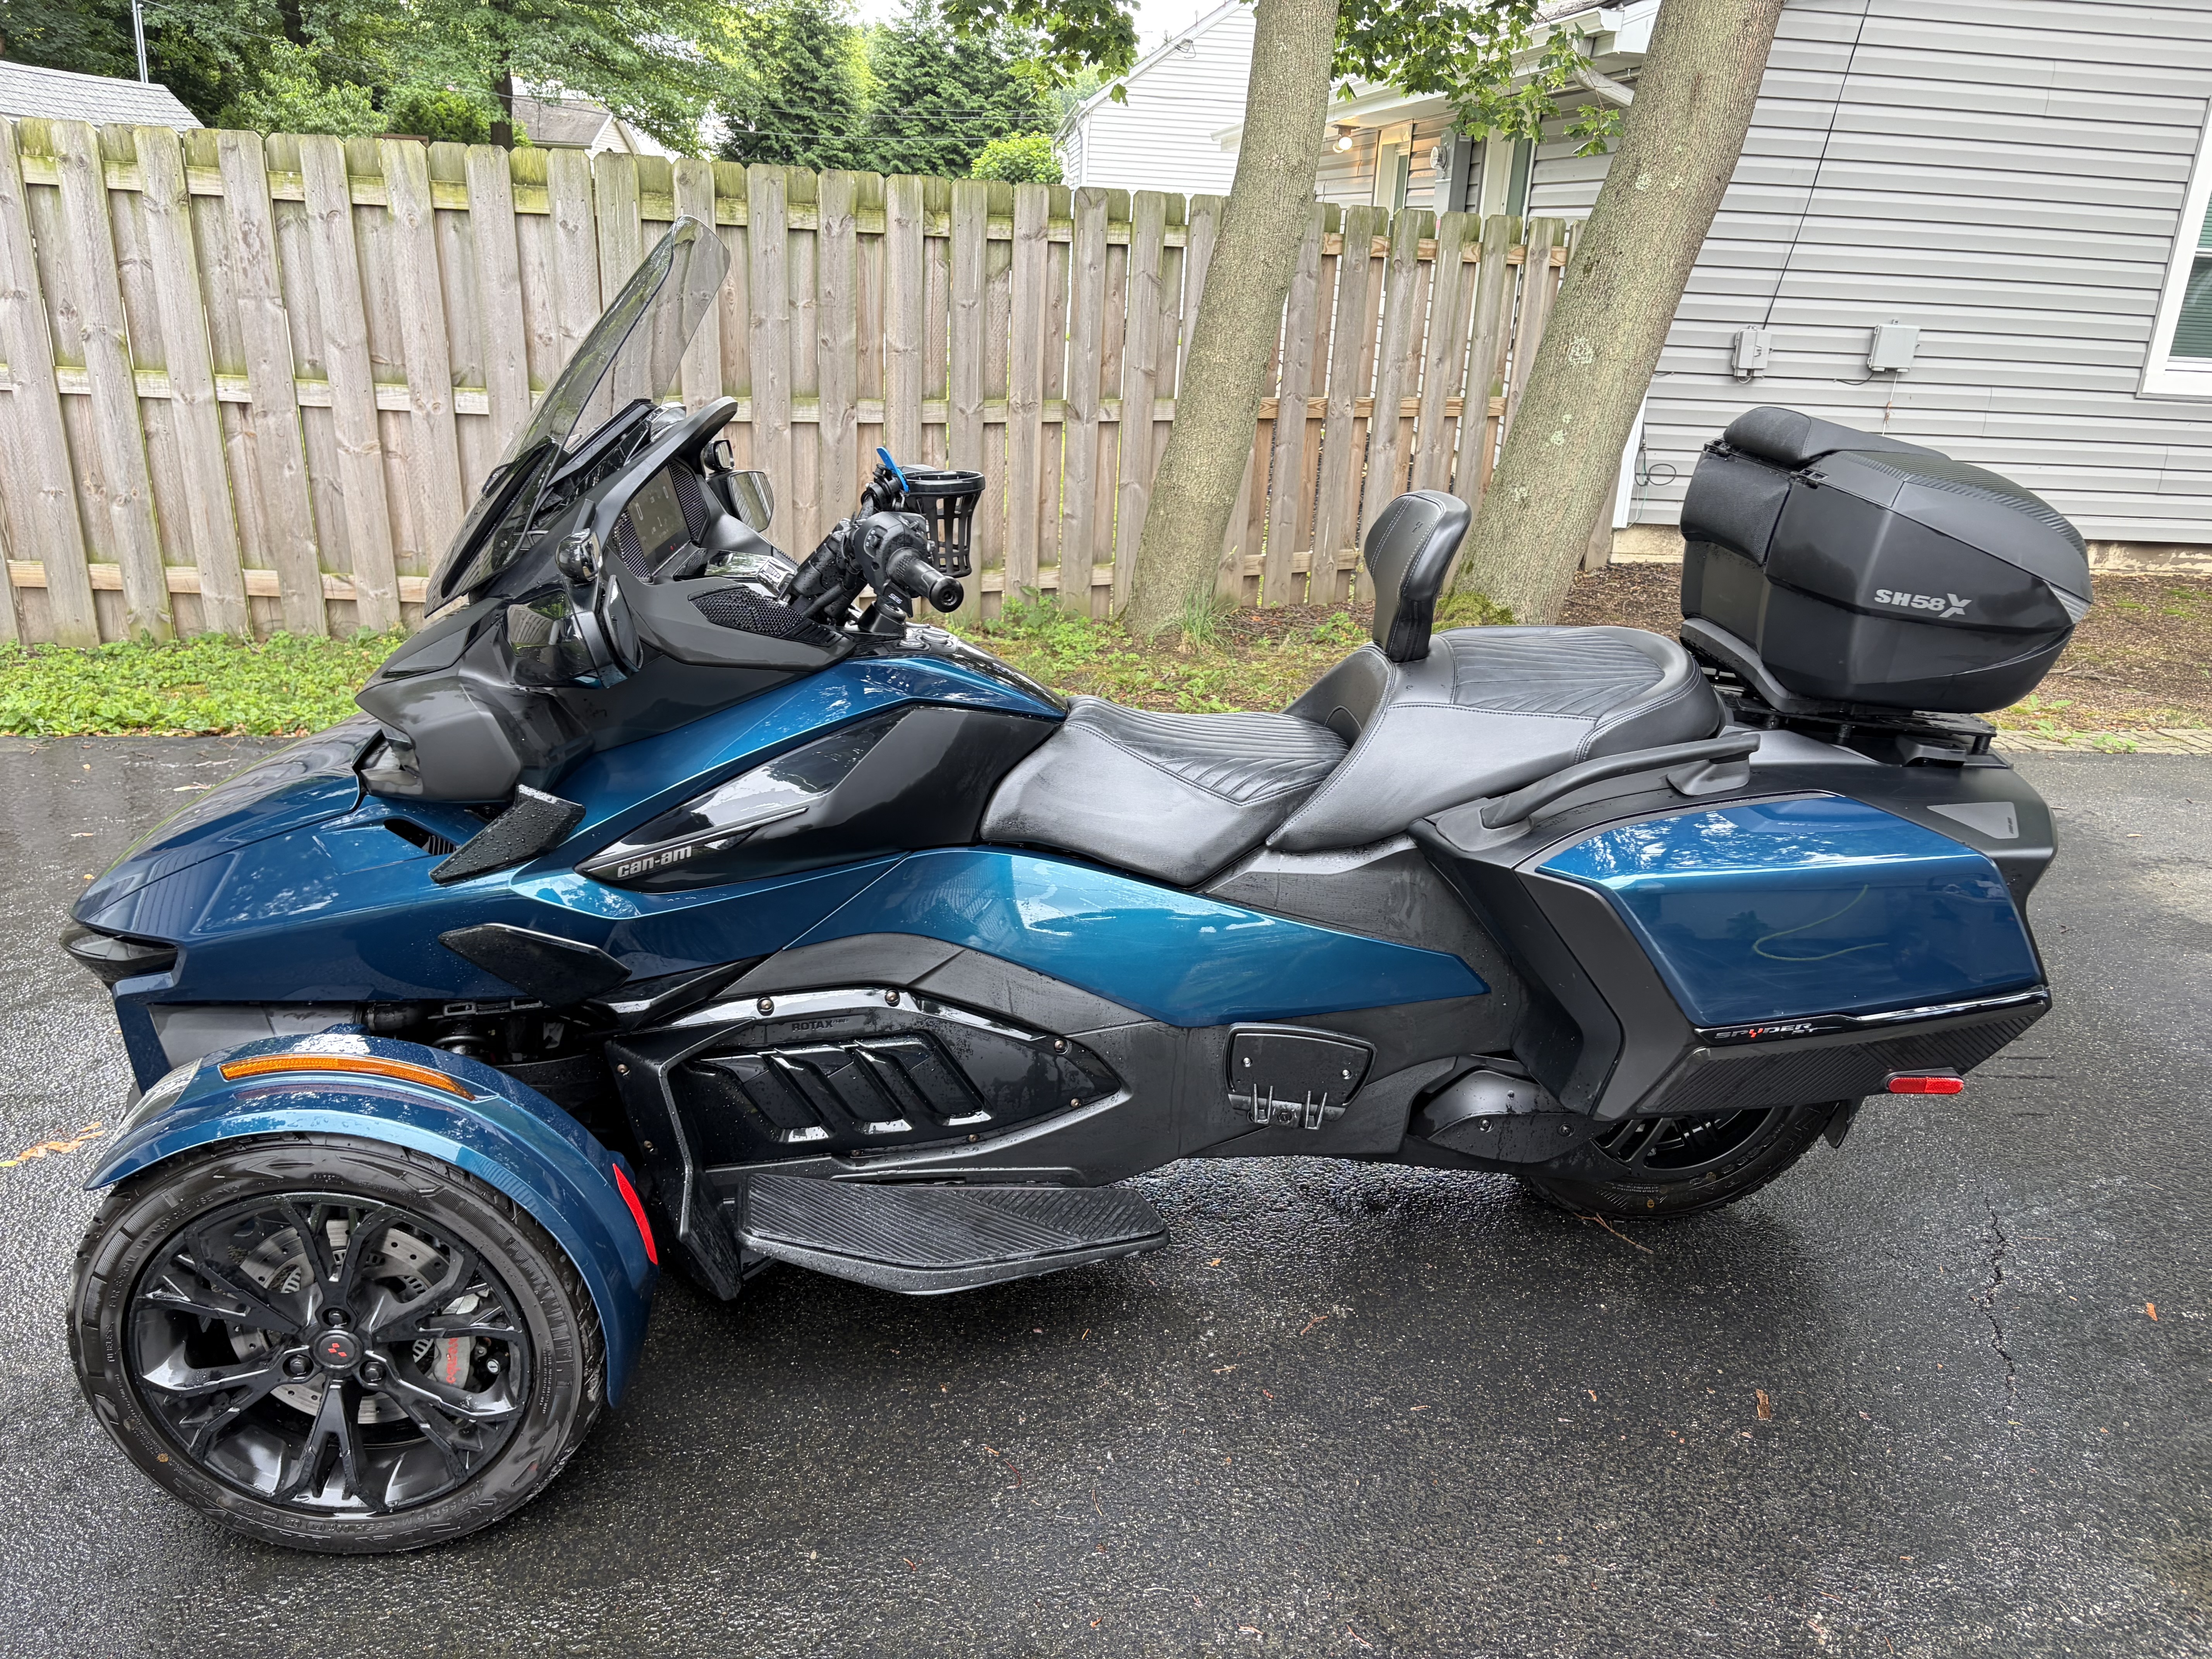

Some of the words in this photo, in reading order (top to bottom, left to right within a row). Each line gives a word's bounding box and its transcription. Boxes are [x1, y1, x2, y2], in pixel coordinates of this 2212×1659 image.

[1874, 589, 1972, 618] SH58X
[617, 845, 692, 878] can-am
[792, 1019, 834, 1032] ROTAX
[1715, 1023, 1812, 1039] SPYDER
[113, 1252, 139, 1287] SPECIAL
[108, 1289, 120, 1308] FOR
